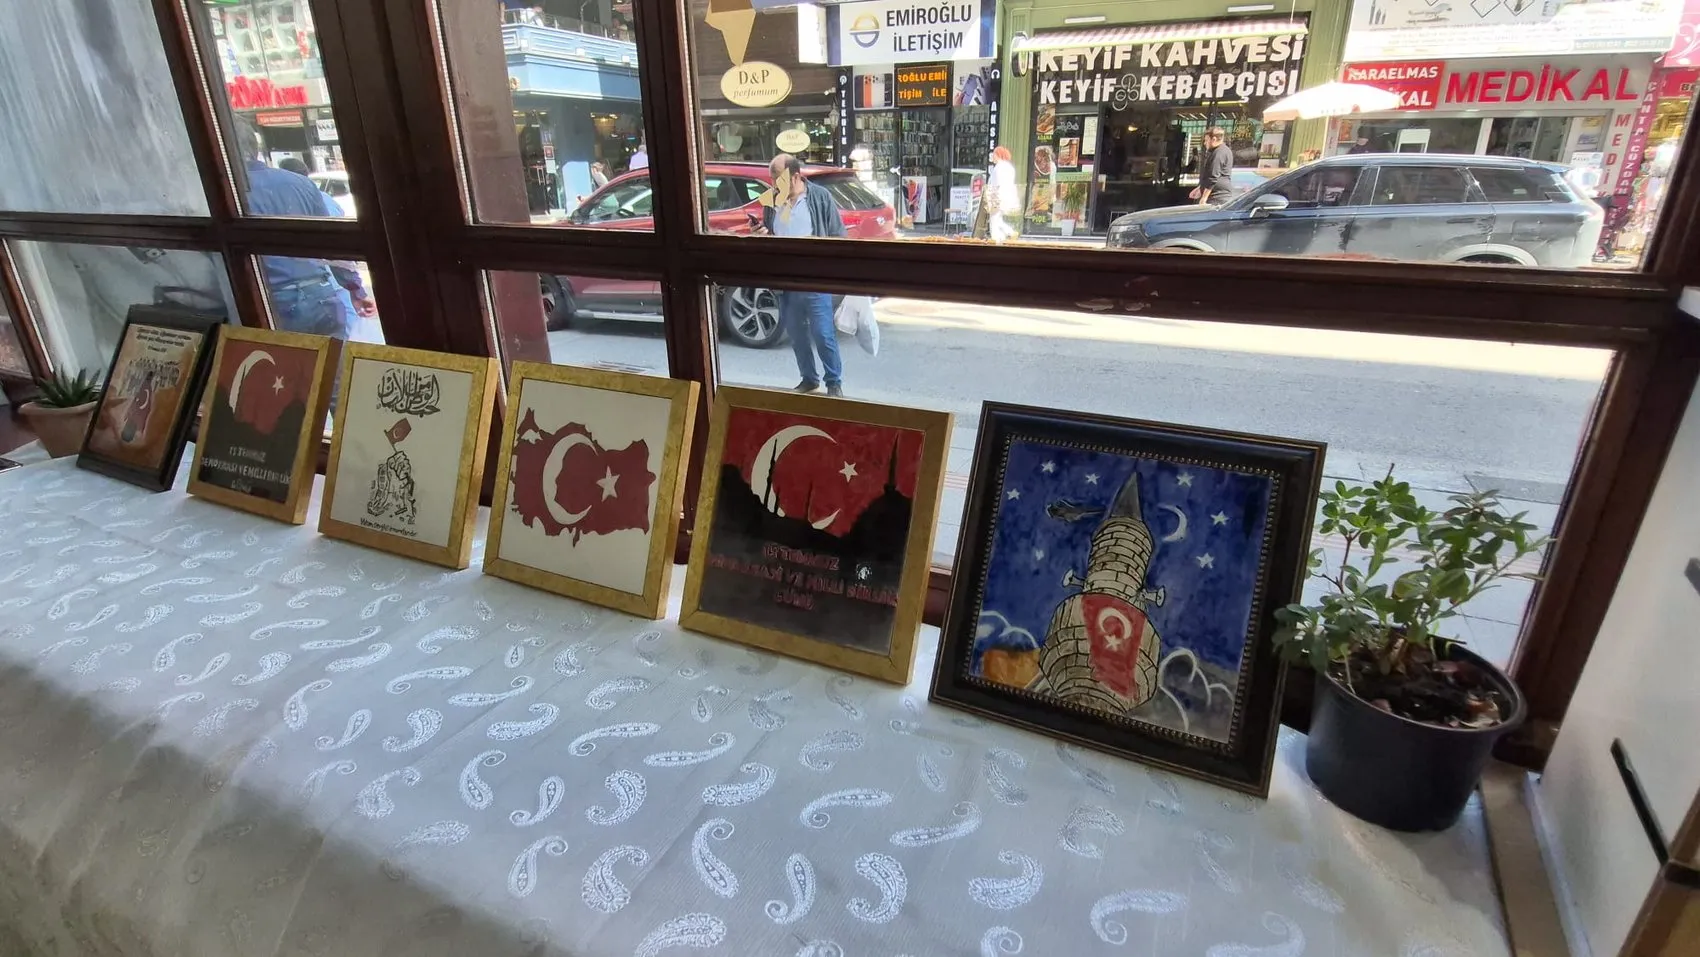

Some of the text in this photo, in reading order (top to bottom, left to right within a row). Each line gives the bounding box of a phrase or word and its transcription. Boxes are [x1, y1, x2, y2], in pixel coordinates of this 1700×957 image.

[886, 1, 972, 27] EMİROĞLU
[893, 28, 963, 55] İLETİŞİM
[1040, 33, 1305, 72] KEYİF KAHVESİ
[738, 69, 770, 85] D&P
[1347, 66, 1438, 81] KARAELMAS
[1444, 63, 1639, 104] MEDİKAL
[733, 88, 778, 99] perfumum
[1040, 74, 1117, 104] KEYİF
